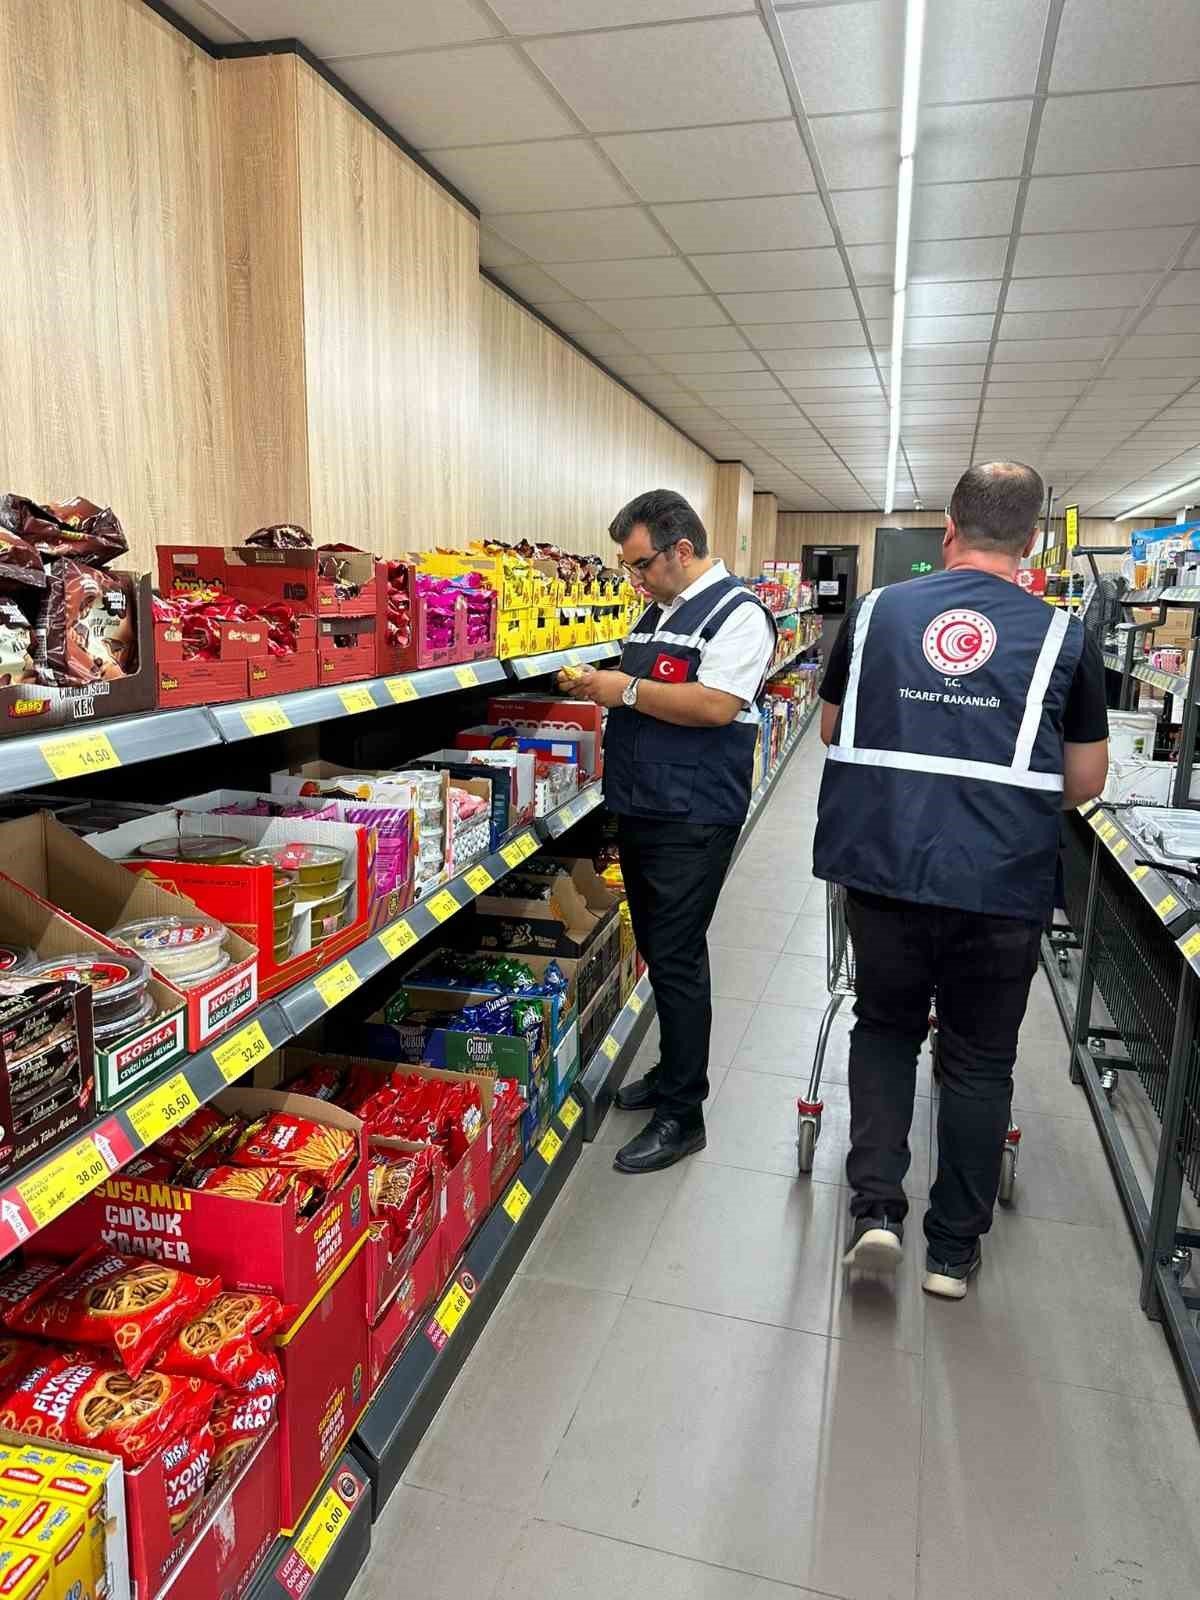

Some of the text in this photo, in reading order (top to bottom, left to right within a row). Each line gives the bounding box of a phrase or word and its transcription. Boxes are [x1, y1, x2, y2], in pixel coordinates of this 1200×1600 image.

[944, 678, 961, 688] T.C.
[73, 697, 94, 718] KEK
[899, 688, 1001, 709] TİCARET BAKANLIĞI
[210, 978, 250, 1011] KOSKA
[120, 1027, 174, 1066] KOSKA
[241, 1039, 265, 1063] 32,50
[161, 1093, 191, 1121] 36,50
[76, 1160, 104, 1186] 38,00
[94, 1180, 192, 1211] SUSAMLI
[105, 1204, 182, 1237] ÇUBUK
[325, 1506, 343, 1533] 6,00
